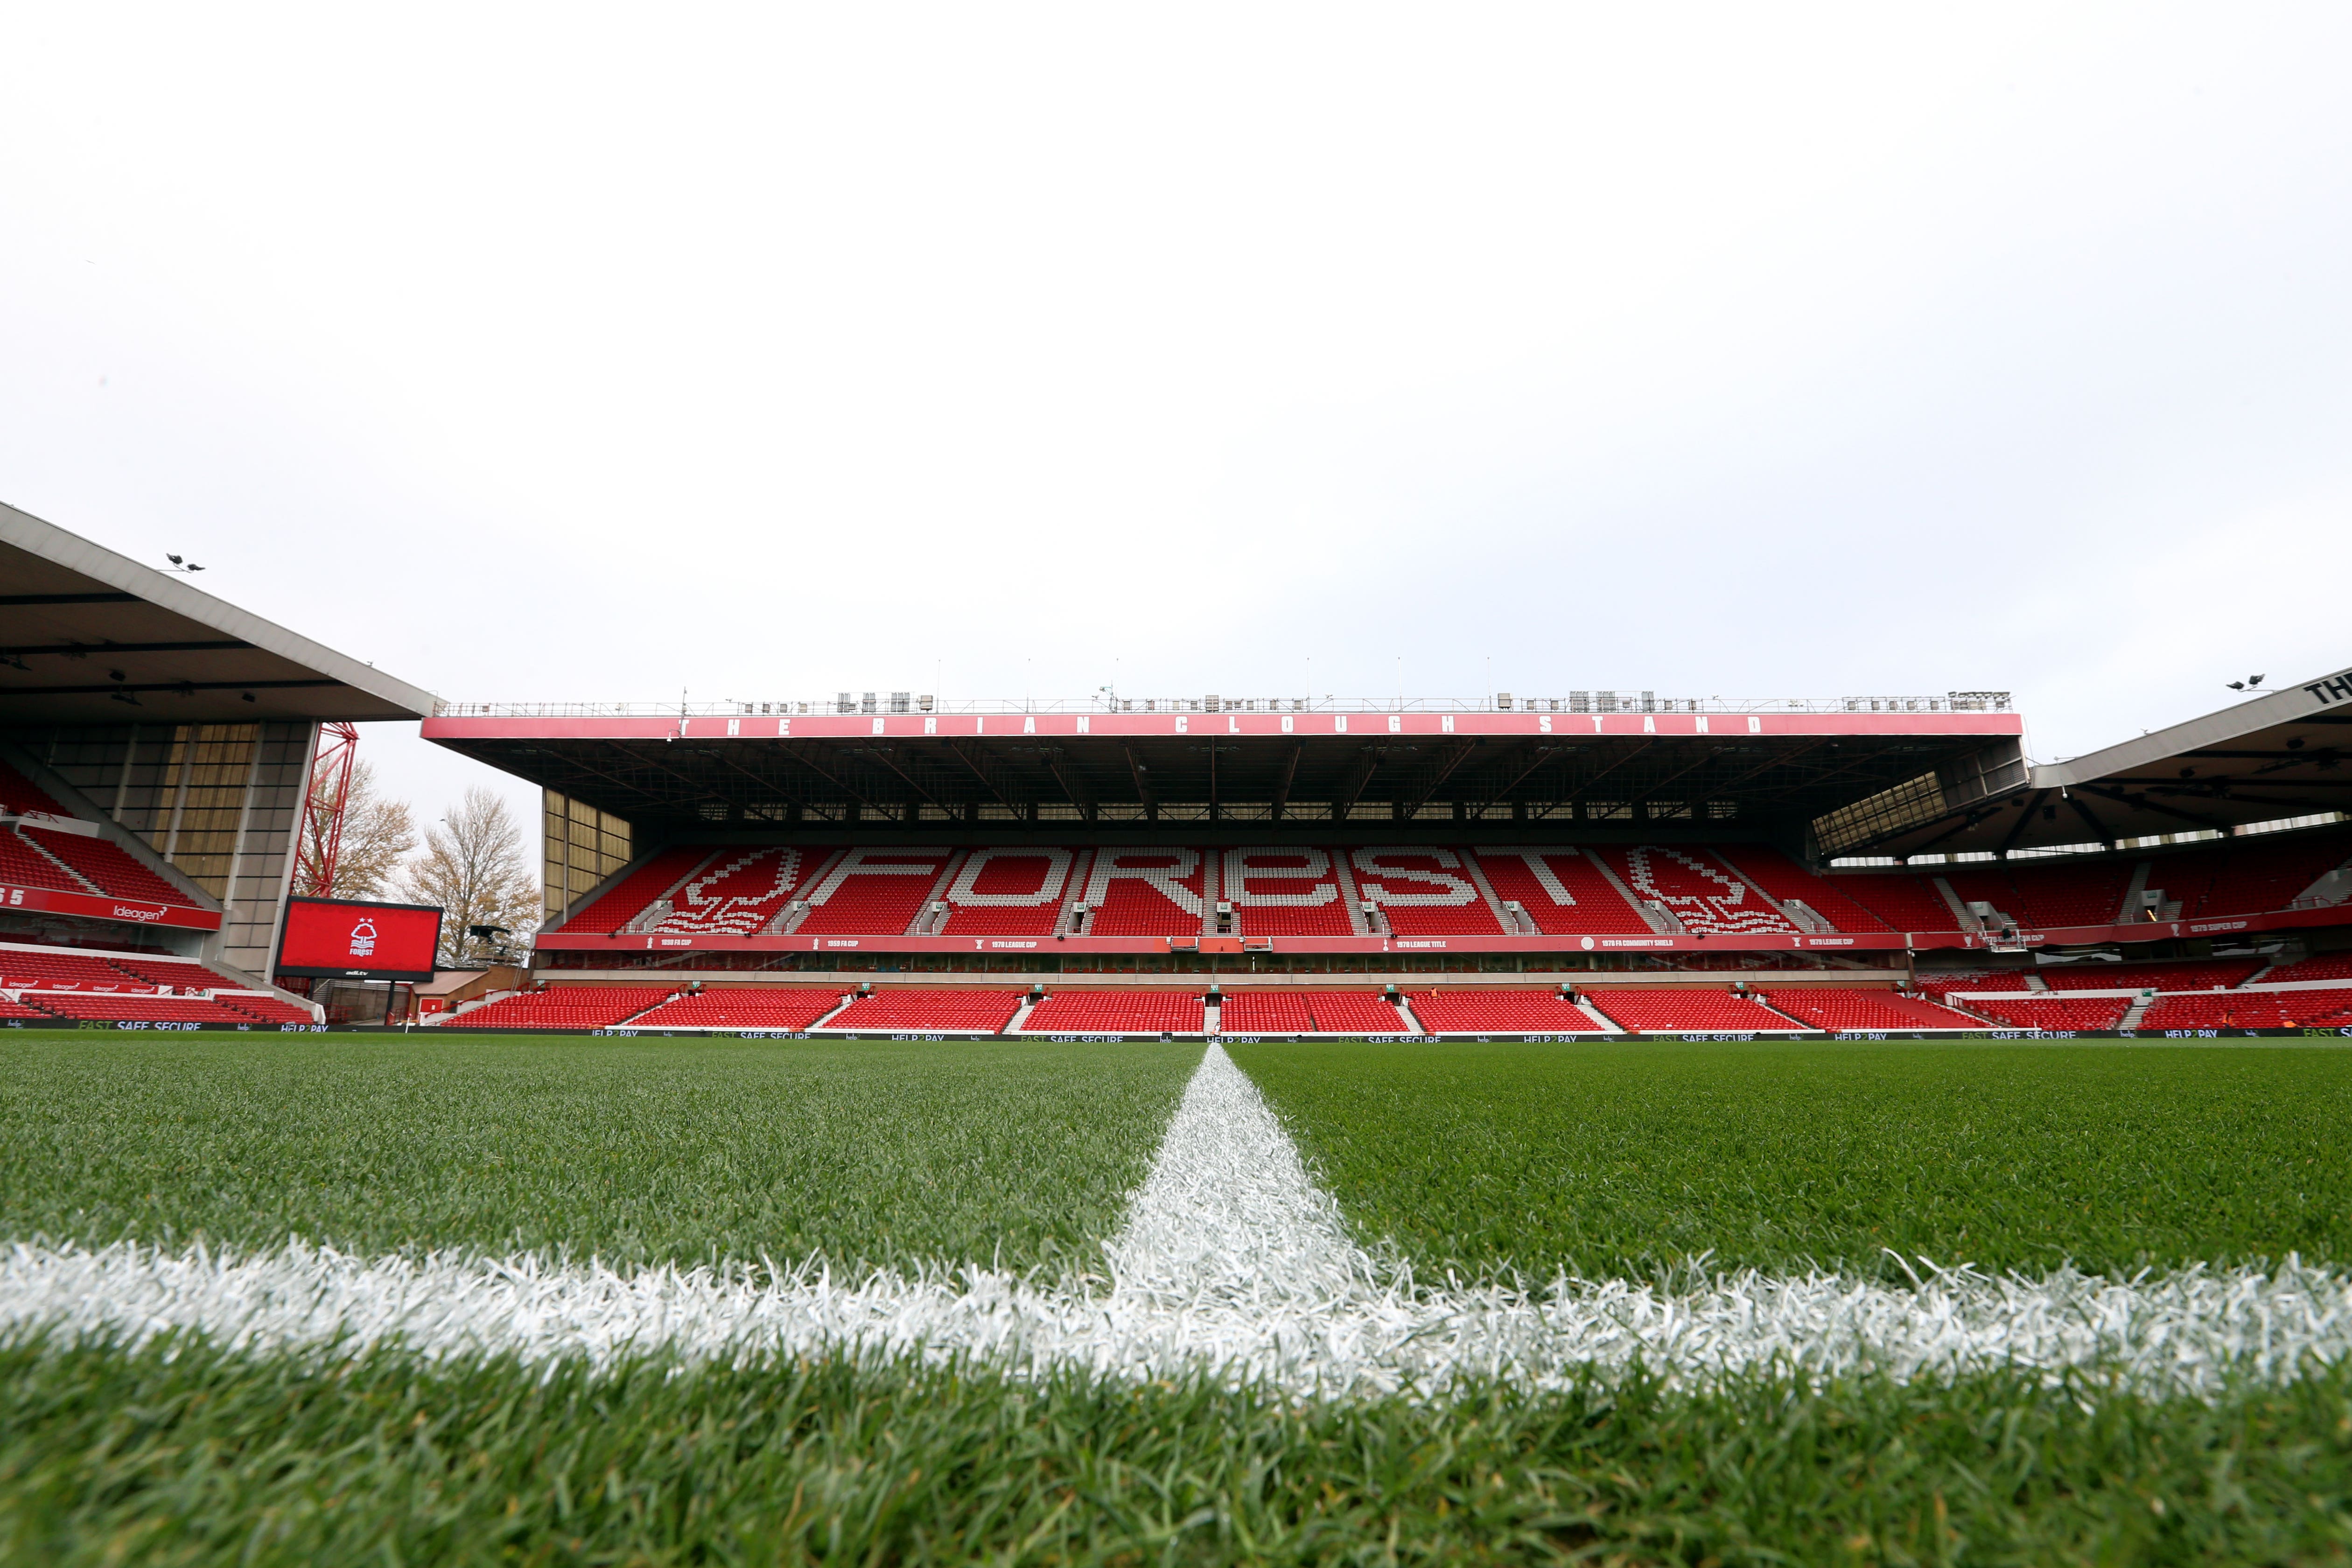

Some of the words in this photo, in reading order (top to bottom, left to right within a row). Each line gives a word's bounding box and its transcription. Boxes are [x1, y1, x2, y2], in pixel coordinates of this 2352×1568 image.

[679, 719, 790, 736] THE
[872, 717, 1090, 735] BRIAN
[1175, 715, 1455, 733] CLOUGH
[1538, 715, 1762, 733] STAND
[113, 905, 159, 921] Ideagen
